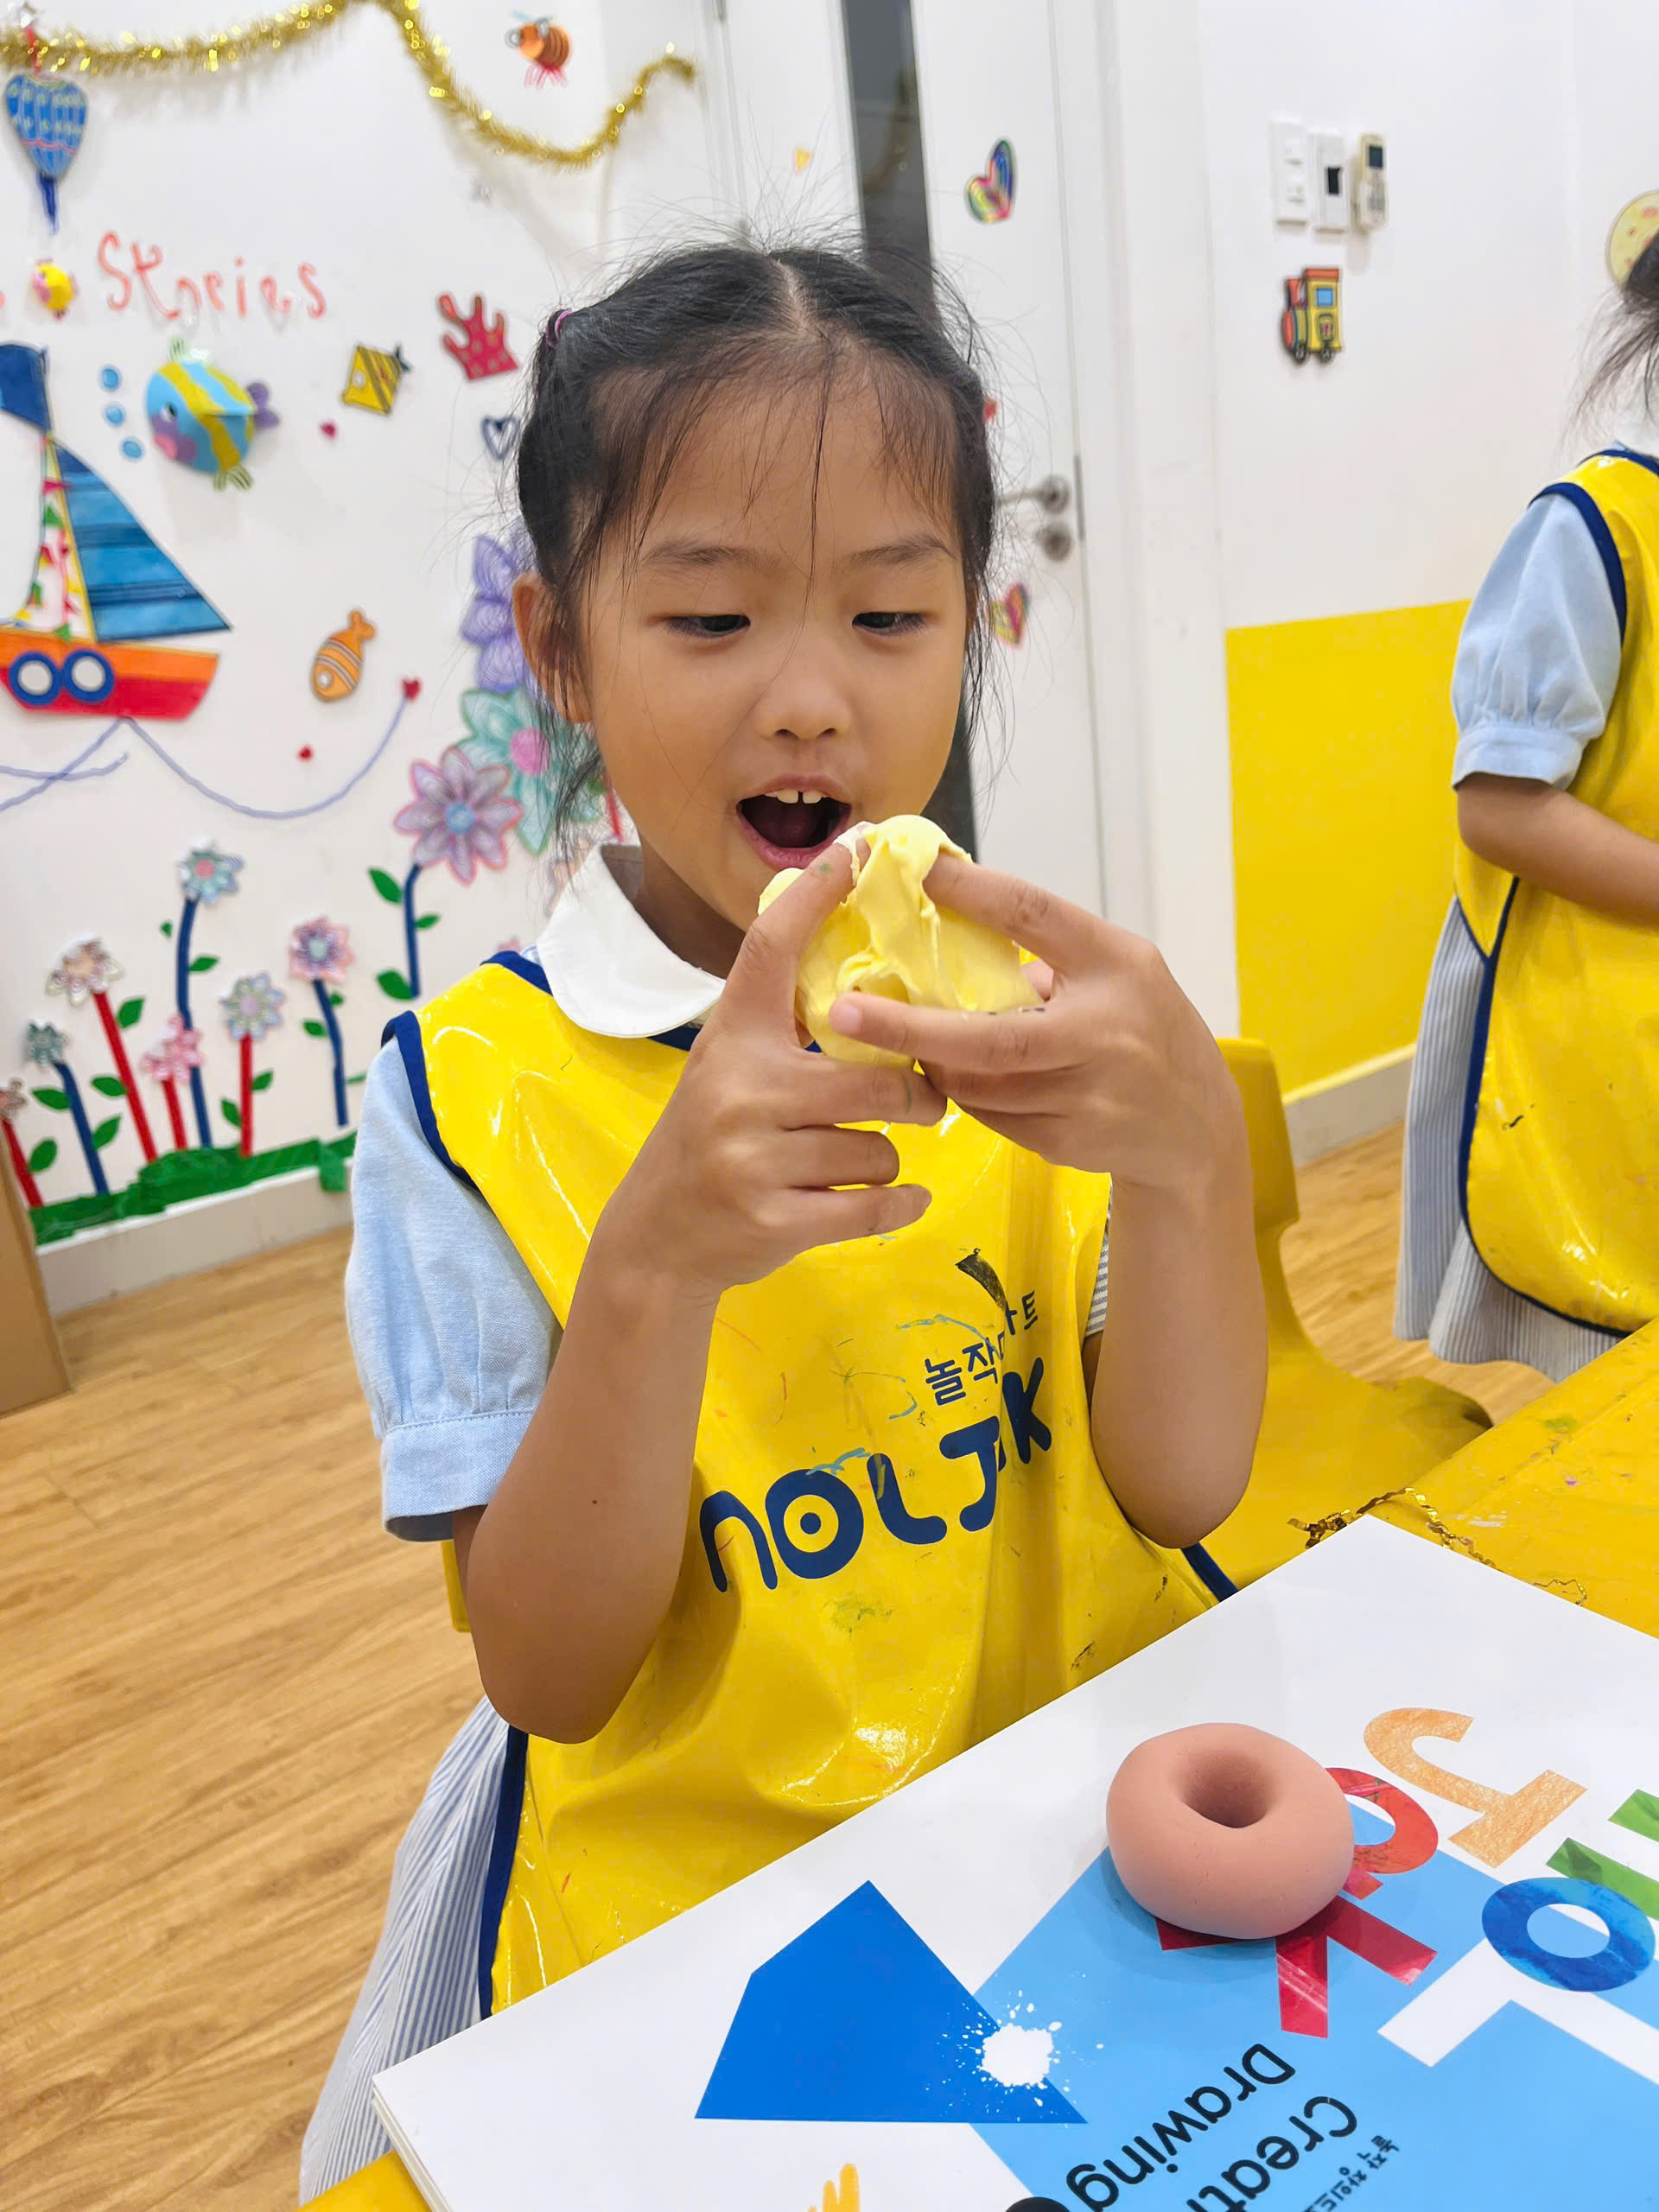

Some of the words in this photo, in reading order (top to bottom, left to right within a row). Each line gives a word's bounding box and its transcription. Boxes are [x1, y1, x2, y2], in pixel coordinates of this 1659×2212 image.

[97, 231, 327, 320] Stories
[1066, 2044, 1295, 2212] Drawing
[1357, 2135, 1400, 2170] 놀작
[1302, 2167, 1368, 2212] 창의드
